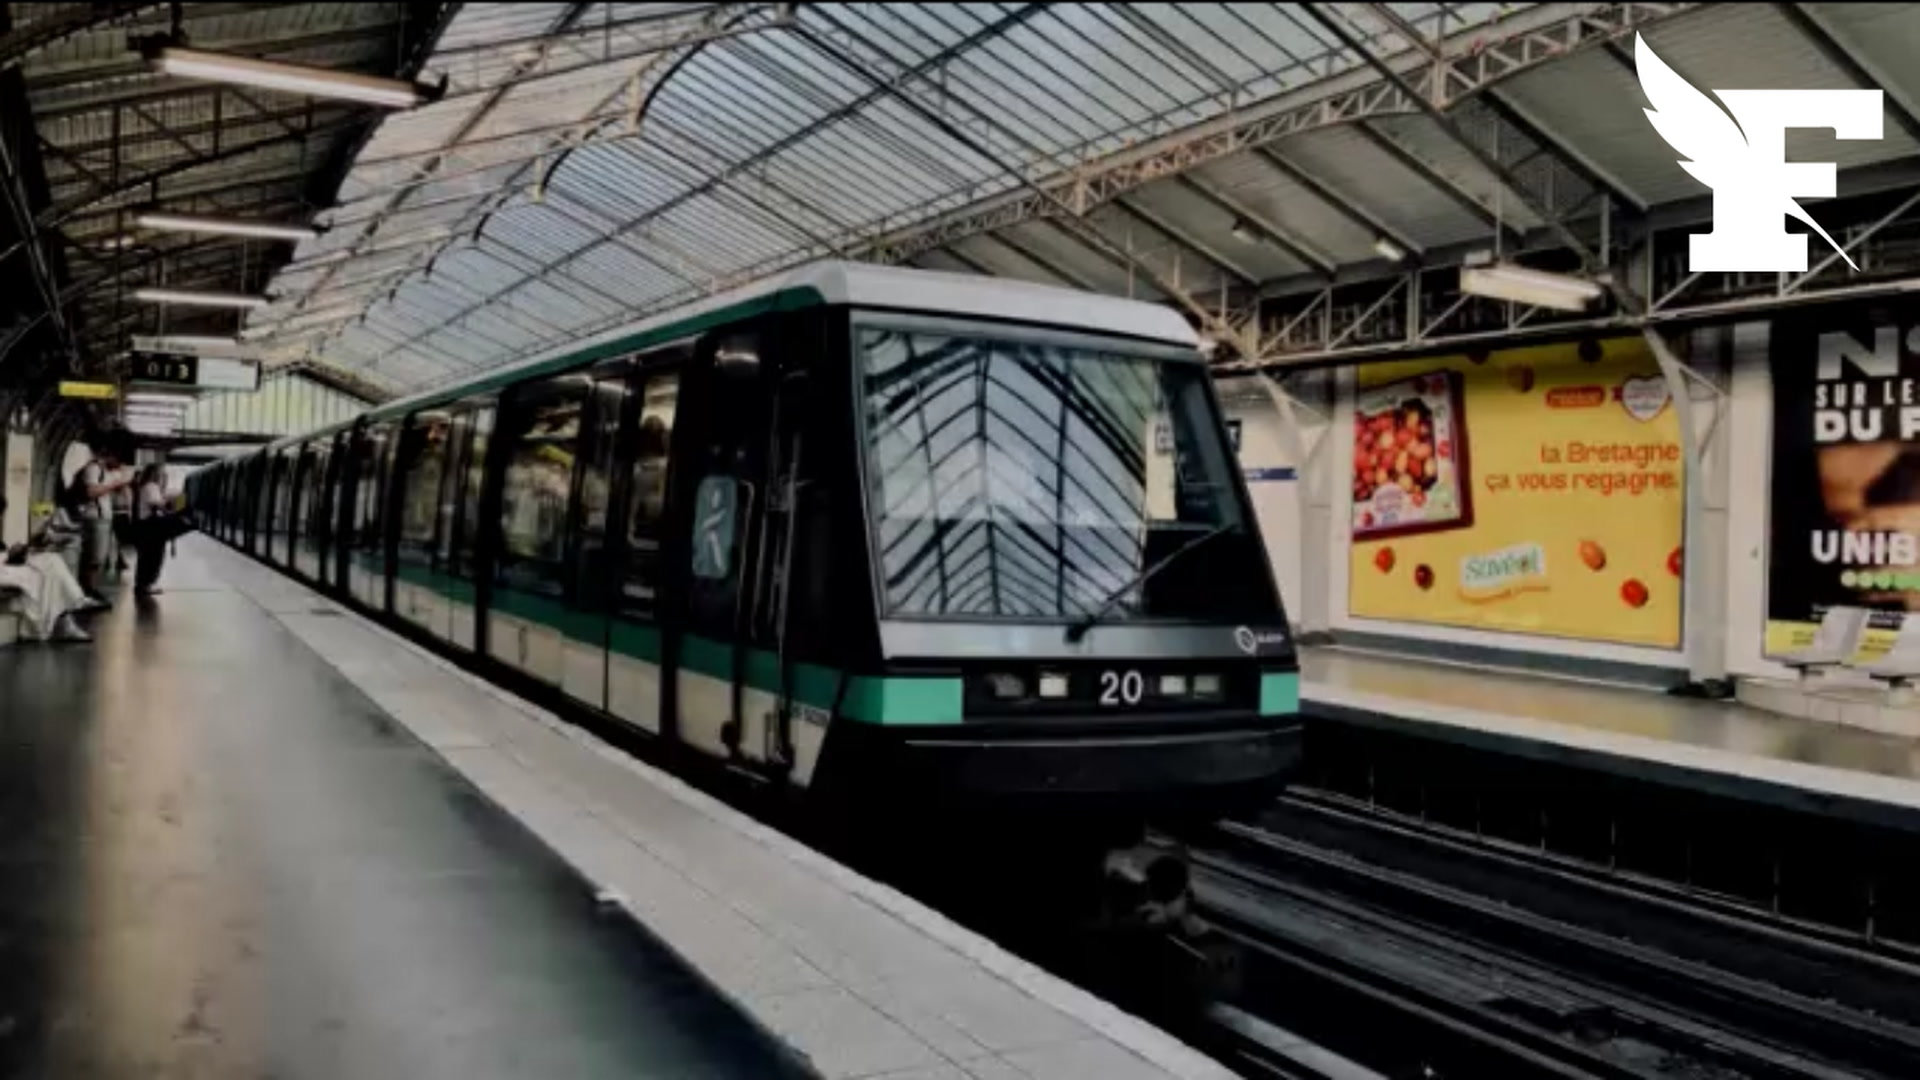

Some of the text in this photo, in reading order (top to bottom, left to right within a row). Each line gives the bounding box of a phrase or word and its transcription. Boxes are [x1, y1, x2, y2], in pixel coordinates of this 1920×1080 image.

[1815, 382, 1867, 407] SUR
[1814, 408, 1882, 441] DU
[1540, 441, 1680, 468] la Bretagne
[1484, 472, 1679, 496] ça vous regagne.
[1811, 530, 1915, 564] UNIB
[1100, 671, 1143, 705] 20
